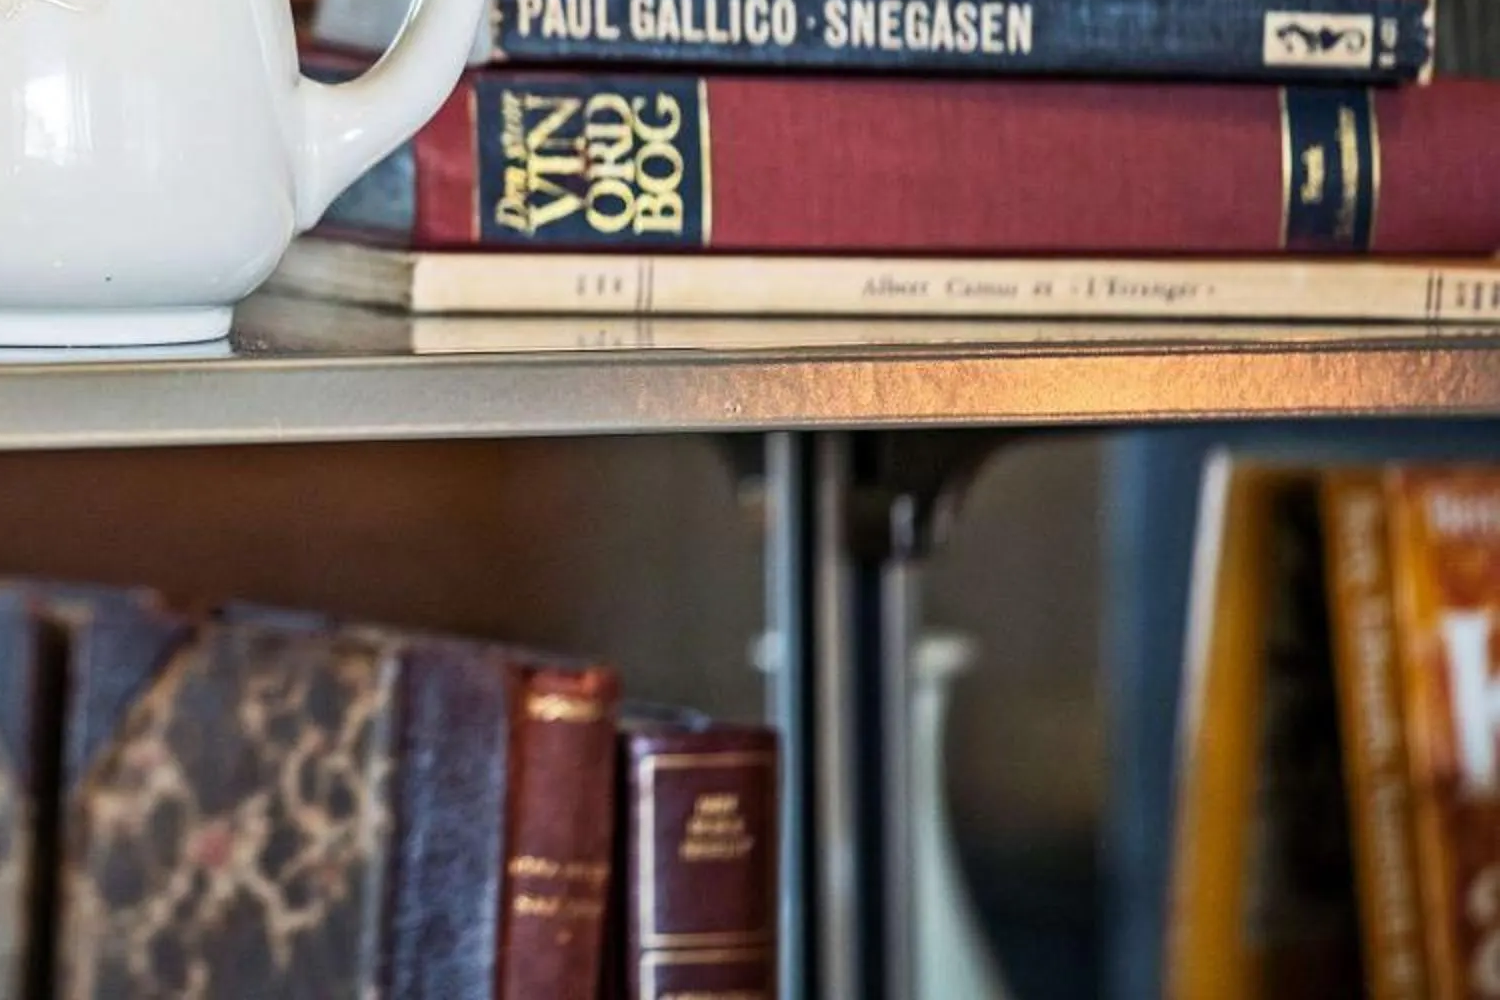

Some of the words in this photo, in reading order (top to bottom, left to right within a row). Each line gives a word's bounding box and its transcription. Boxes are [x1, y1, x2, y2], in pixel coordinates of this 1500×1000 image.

[525, 92, 586, 236] VIN
[582, 92, 635, 233] ORD
[631, 91, 684, 236] BOG
